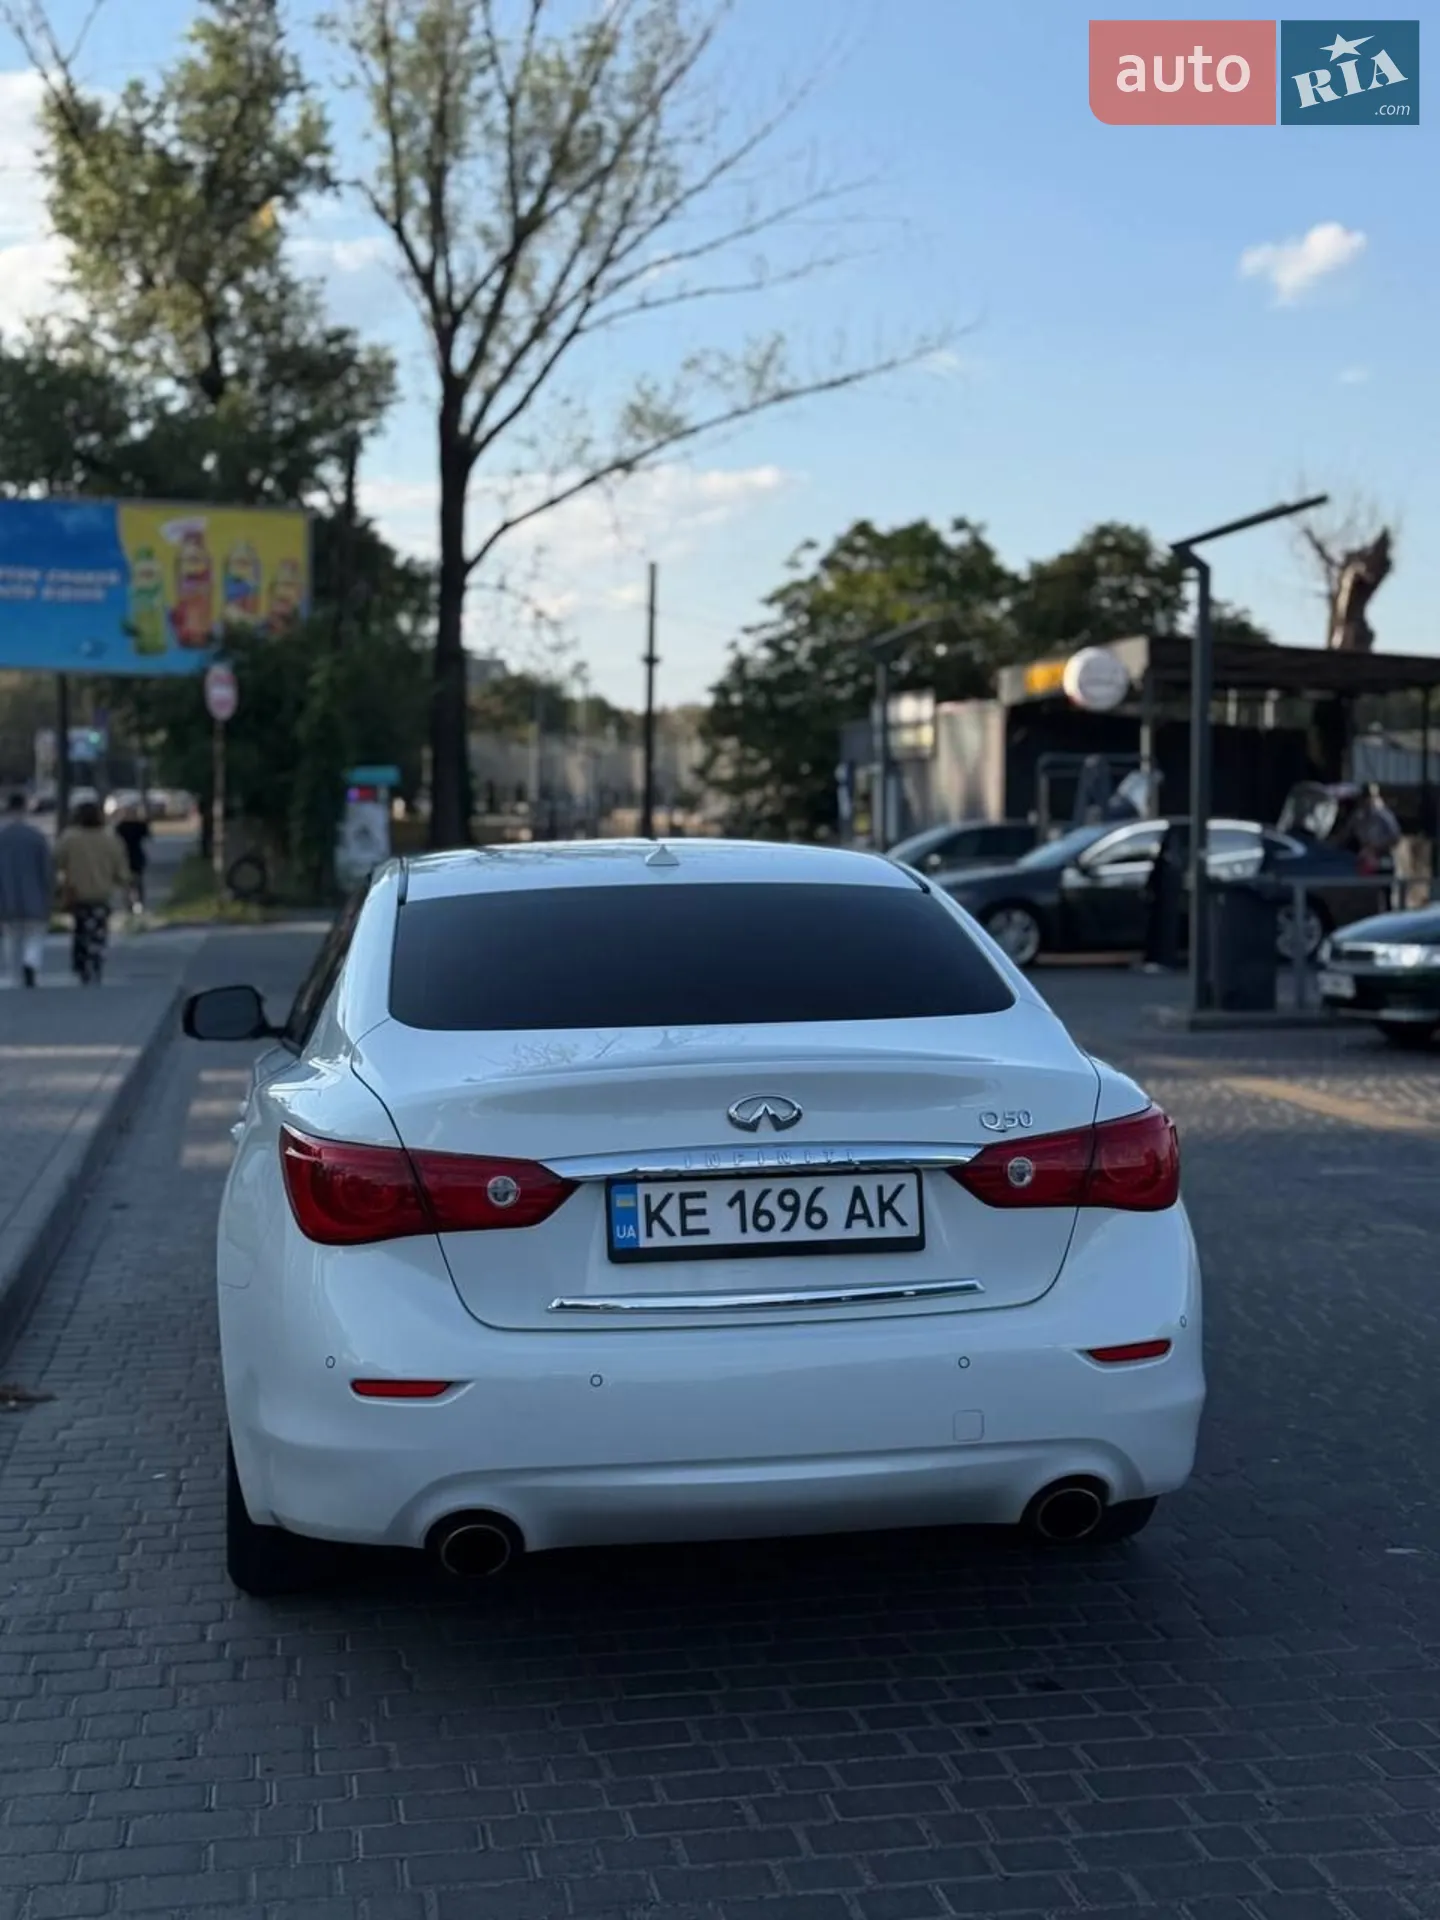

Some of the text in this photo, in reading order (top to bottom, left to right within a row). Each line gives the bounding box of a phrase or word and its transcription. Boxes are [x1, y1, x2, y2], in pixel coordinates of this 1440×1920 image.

[979, 1109, 1034, 1134] Q50
[683, 1149, 857, 1170] INFINITI
[643, 1182, 909, 1239] KE 1696 AK
[616, 1224, 636, 1240] UA
